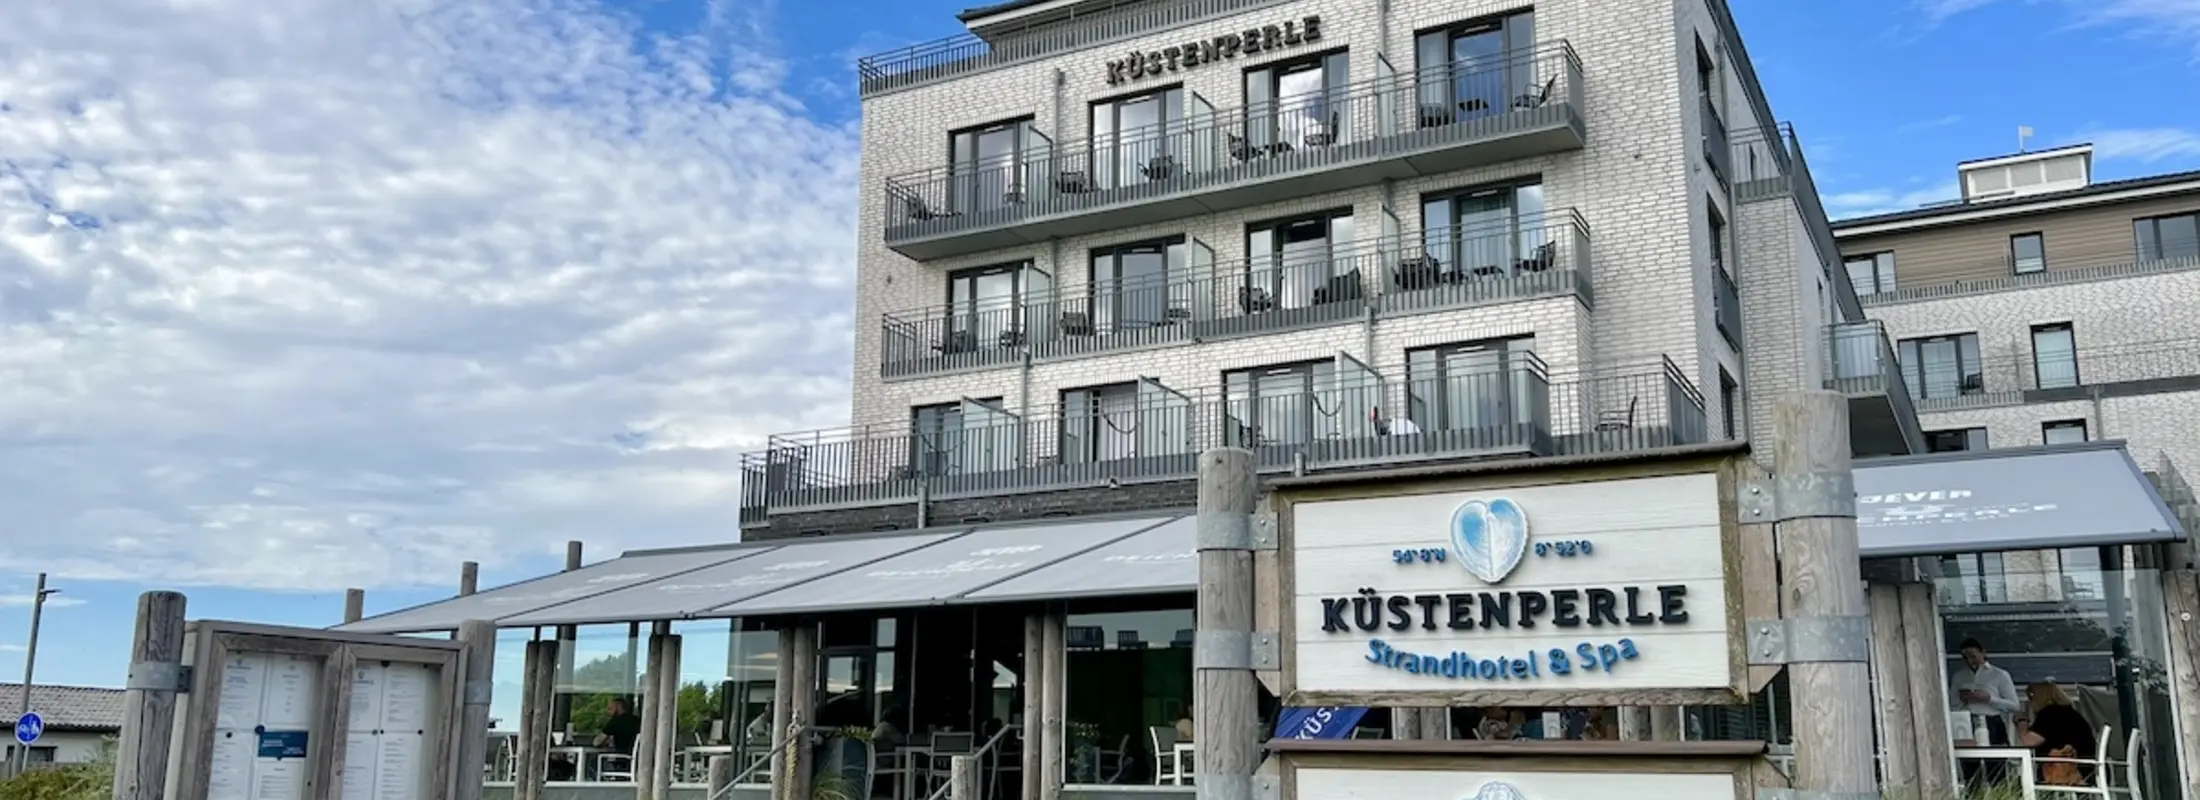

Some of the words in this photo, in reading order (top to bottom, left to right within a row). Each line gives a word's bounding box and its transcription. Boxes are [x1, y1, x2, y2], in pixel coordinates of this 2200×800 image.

[1106, 15, 1321, 85] KÜSTENPERLE
[1321, 584, 1689, 633] KÜSTENPERLE
[1365, 638, 1540, 680] Strandhotel
[1549, 647, 1572, 676] &
[1576, 637, 1640, 673] Spa
